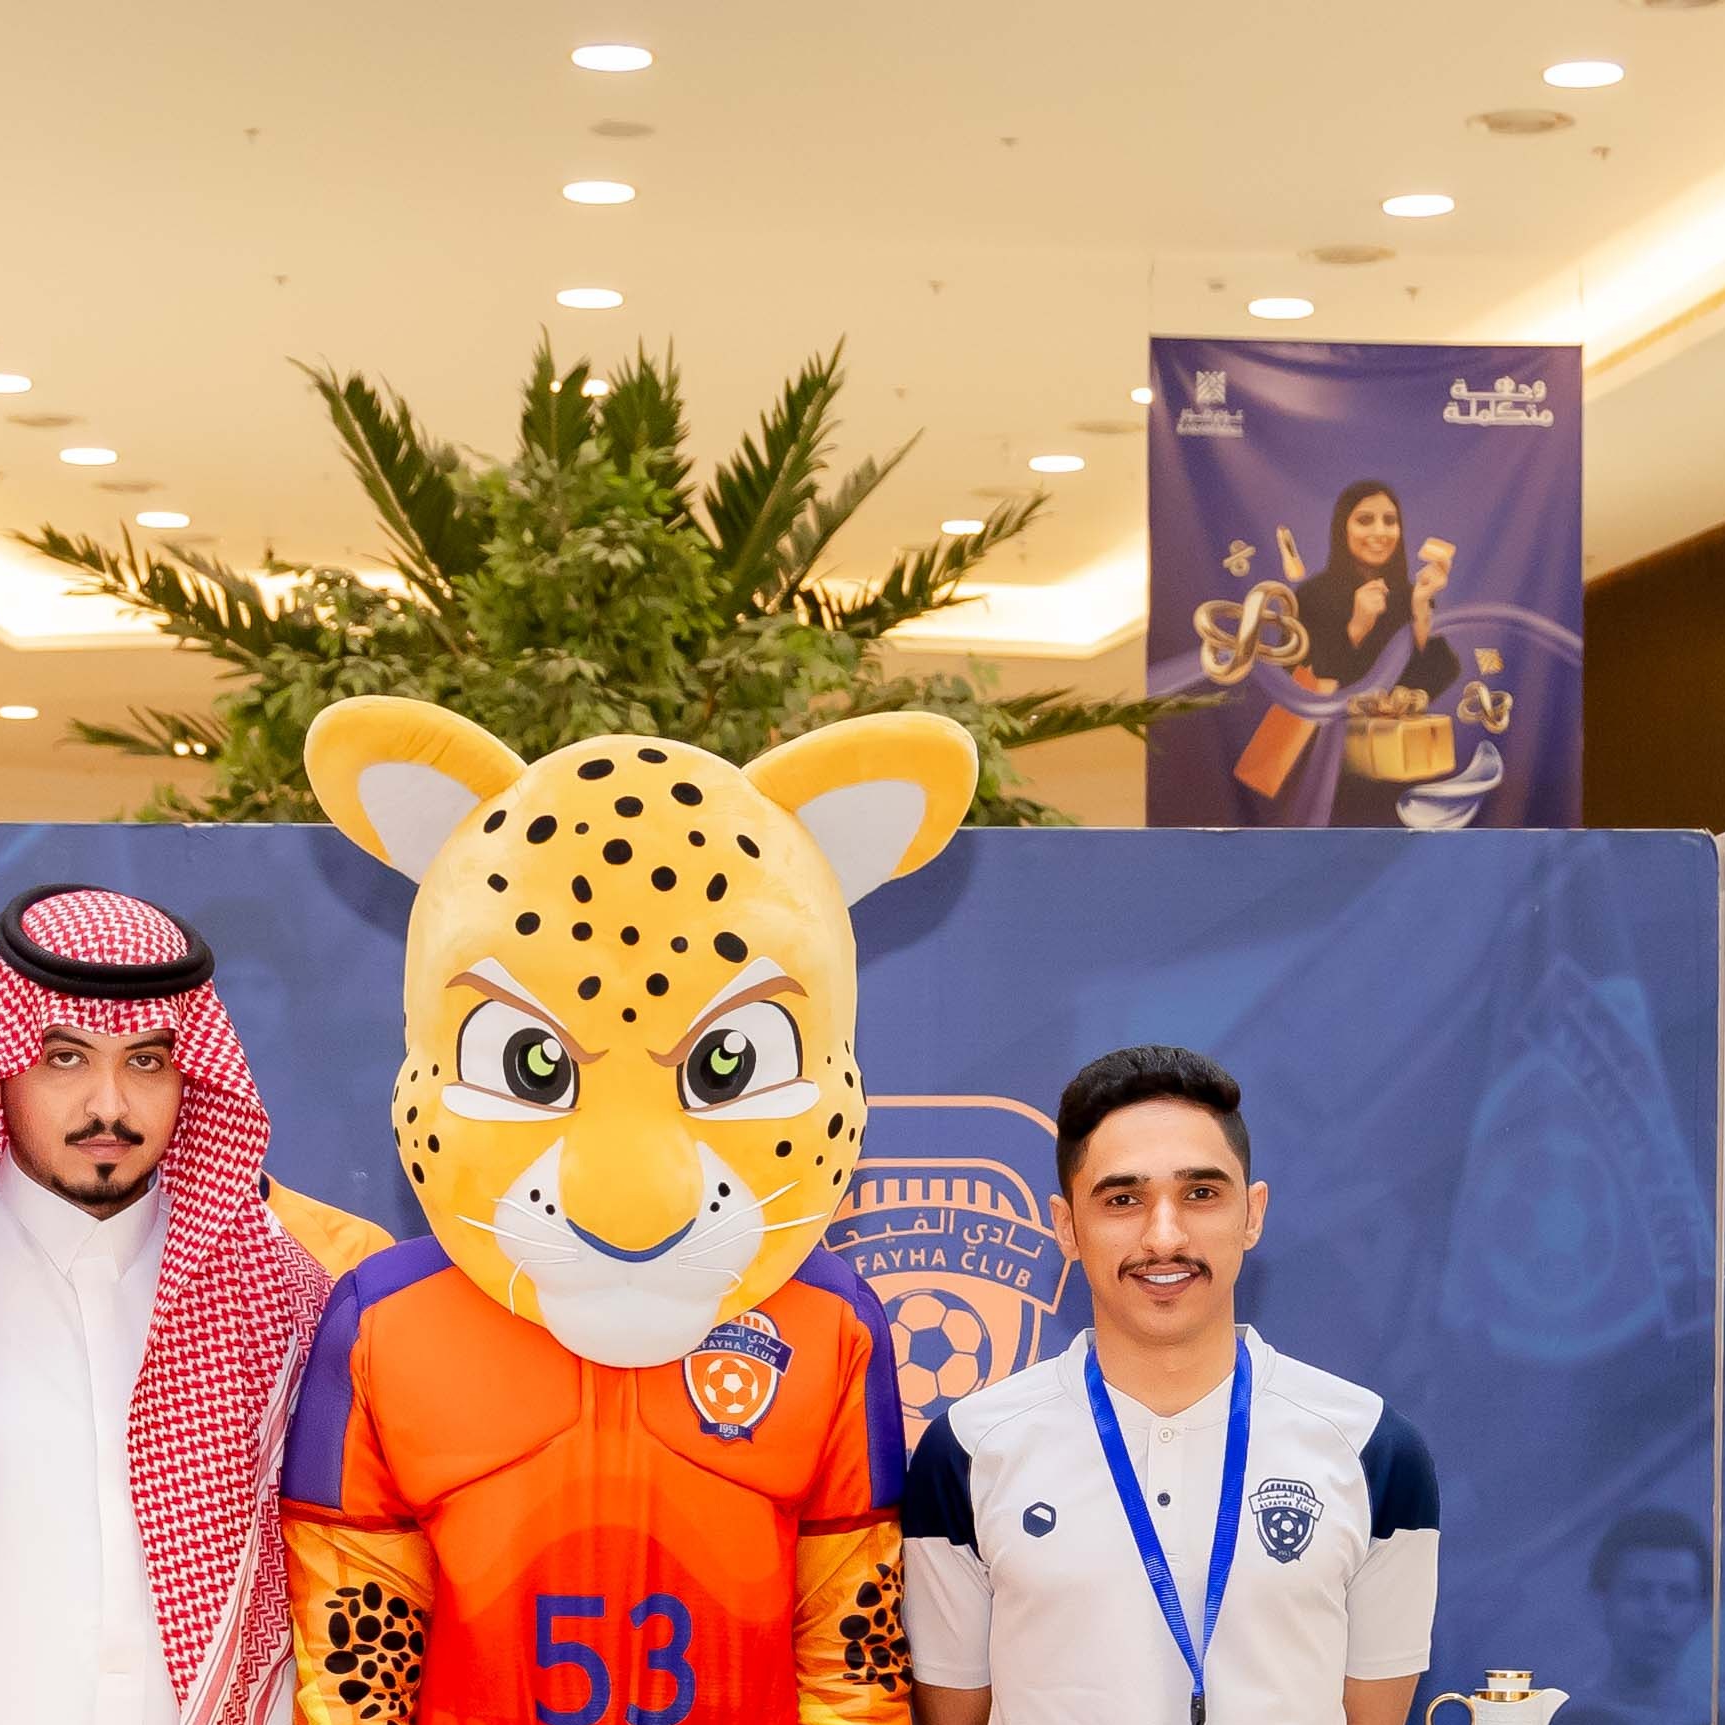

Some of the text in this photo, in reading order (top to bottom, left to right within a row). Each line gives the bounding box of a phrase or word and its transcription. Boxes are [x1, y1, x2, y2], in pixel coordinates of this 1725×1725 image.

[821, 1208, 1045, 1259] نادي الفيحا
[855, 1248, 1032, 1288] FAYHA CLUB
[702, 1339, 777, 1365] FAYHA CLUB
[718, 1423, 739, 1436] 1953
